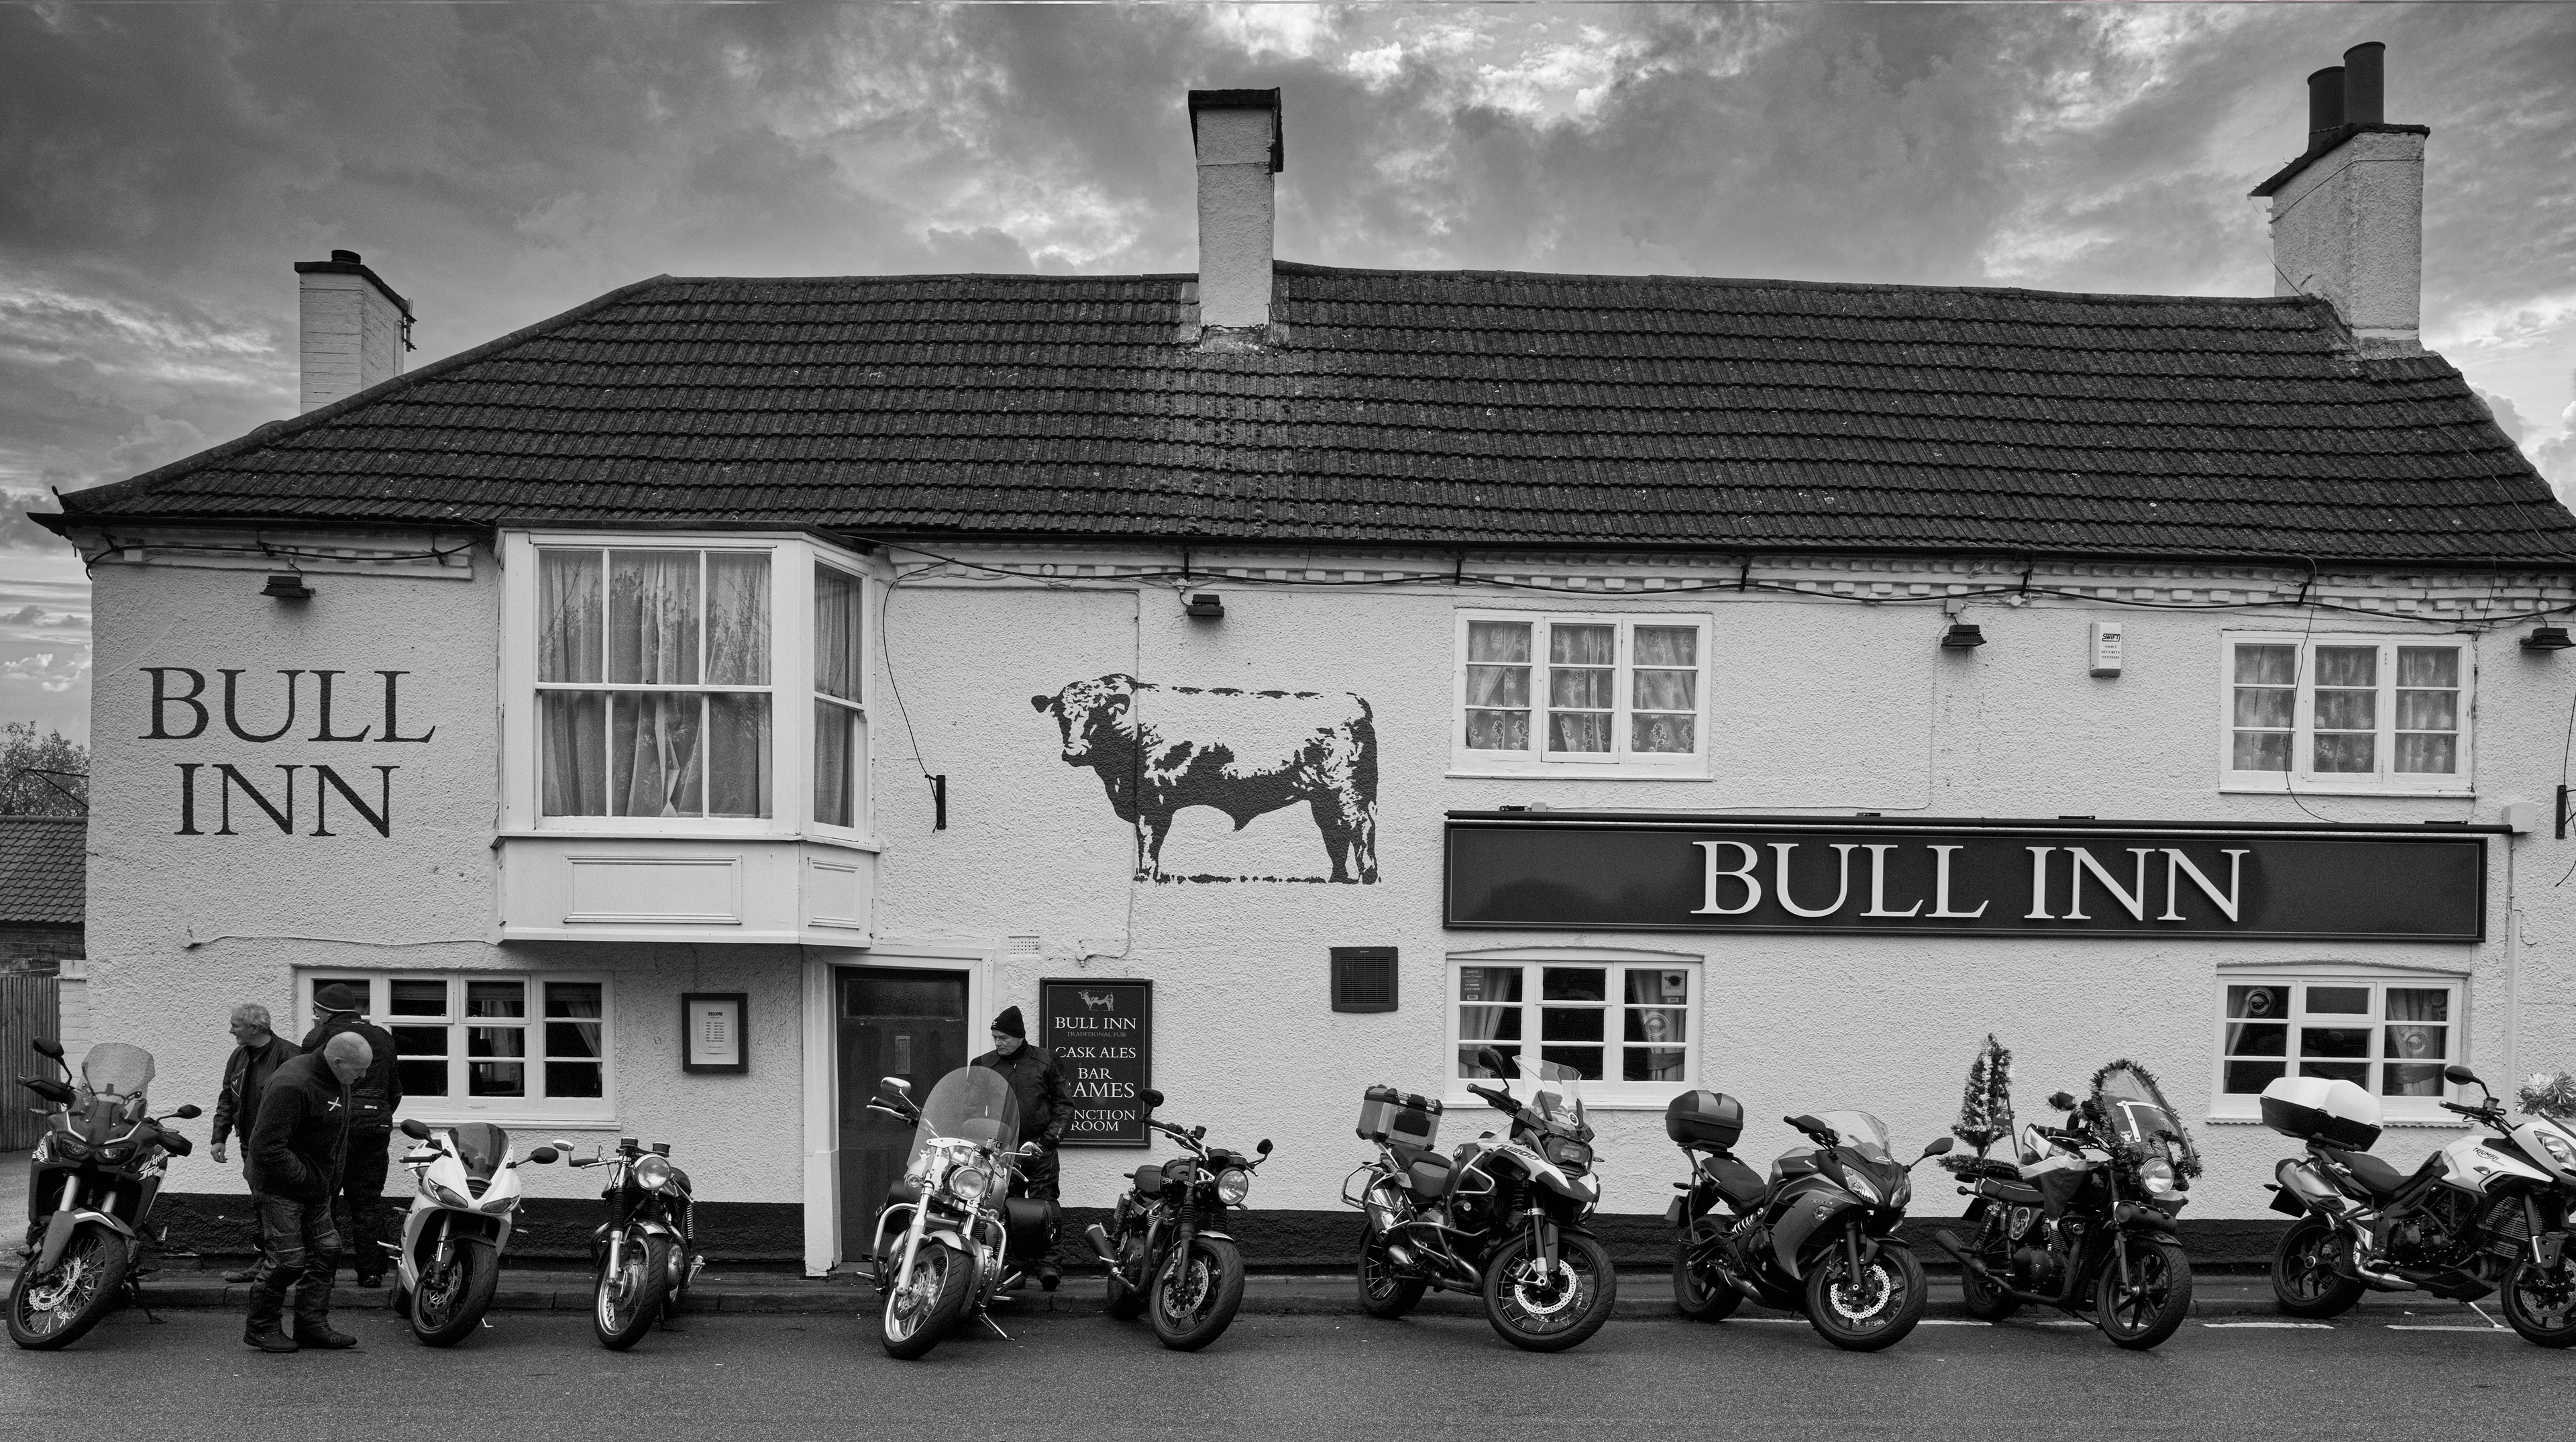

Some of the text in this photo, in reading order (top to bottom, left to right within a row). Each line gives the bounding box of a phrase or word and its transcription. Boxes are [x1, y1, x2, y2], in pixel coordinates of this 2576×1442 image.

[138, 667, 436, 743] BULL
[174, 763, 400, 838] INN
[1690, 839, 2250, 923] BULL INN
[1055, 1017, 1137, 1029] BULL INN
[1055, 1046, 1136, 1059] CASK ALES
[1077, 1068, 1113, 1080] BAR
[351, 1088, 384, 1096] RST
[1069, 1082, 1134, 1098] AMES
[1074, 1109, 1136, 1121] NCTION
[1071, 1121, 1119, 1131] ROOM
[1496, 1143, 1540, 1161] R1200
[2473, 1147, 2500, 1160] TRIUMPH
